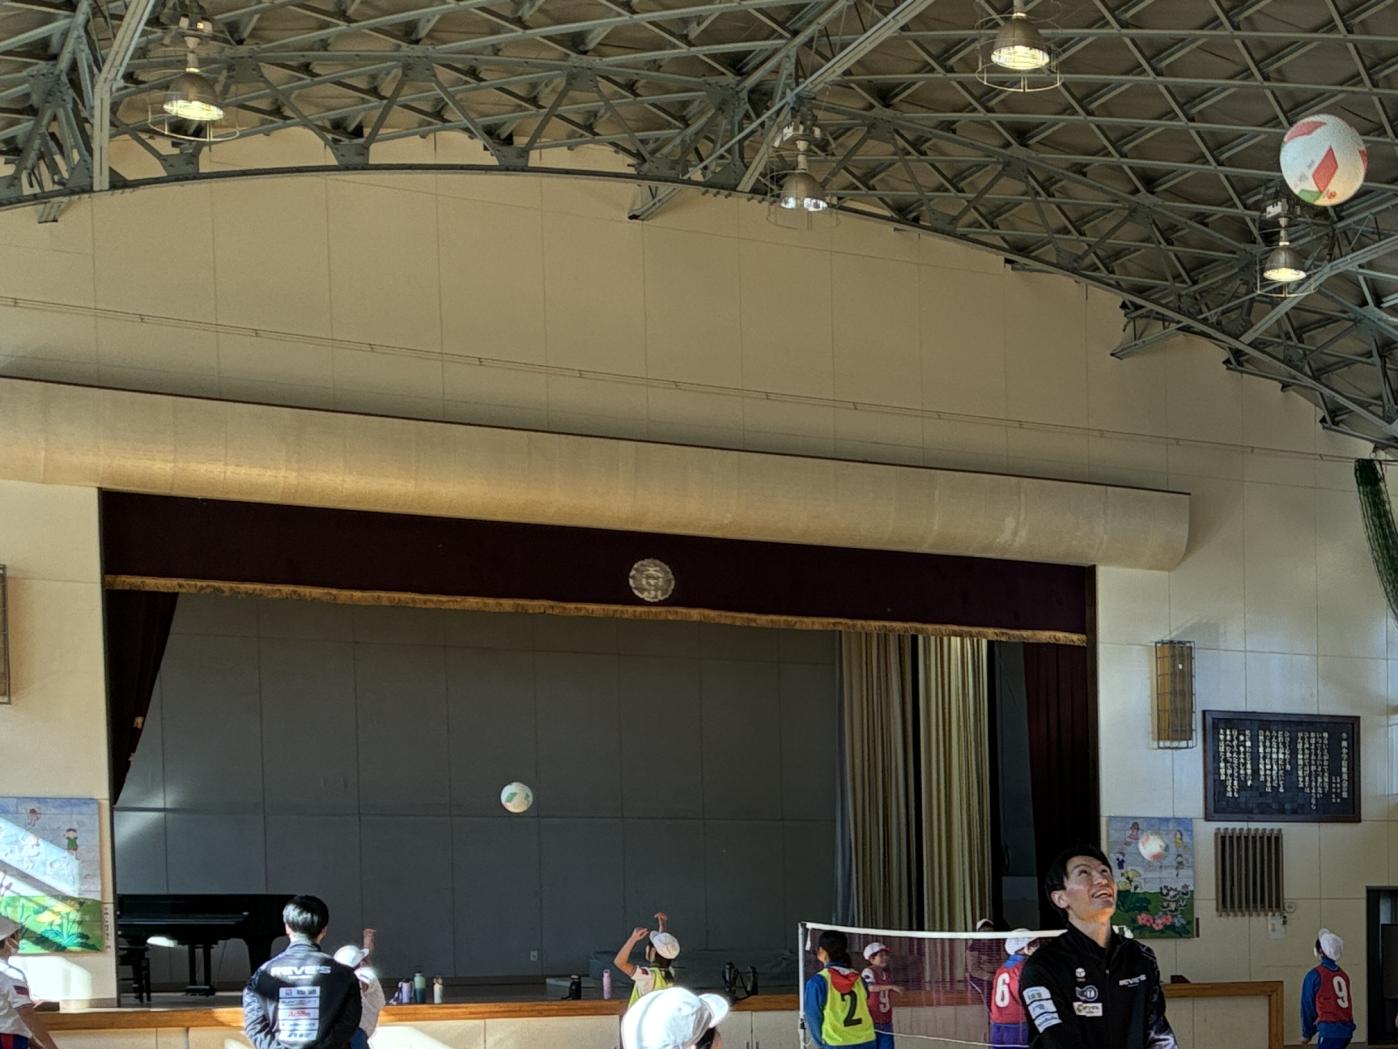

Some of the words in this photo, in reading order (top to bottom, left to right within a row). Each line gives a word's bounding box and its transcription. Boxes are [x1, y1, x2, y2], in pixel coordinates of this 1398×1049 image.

[995, 971, 1010, 1007] 6
[1332, 975, 1349, 1008] 9
[841, 989, 863, 1027] 2
